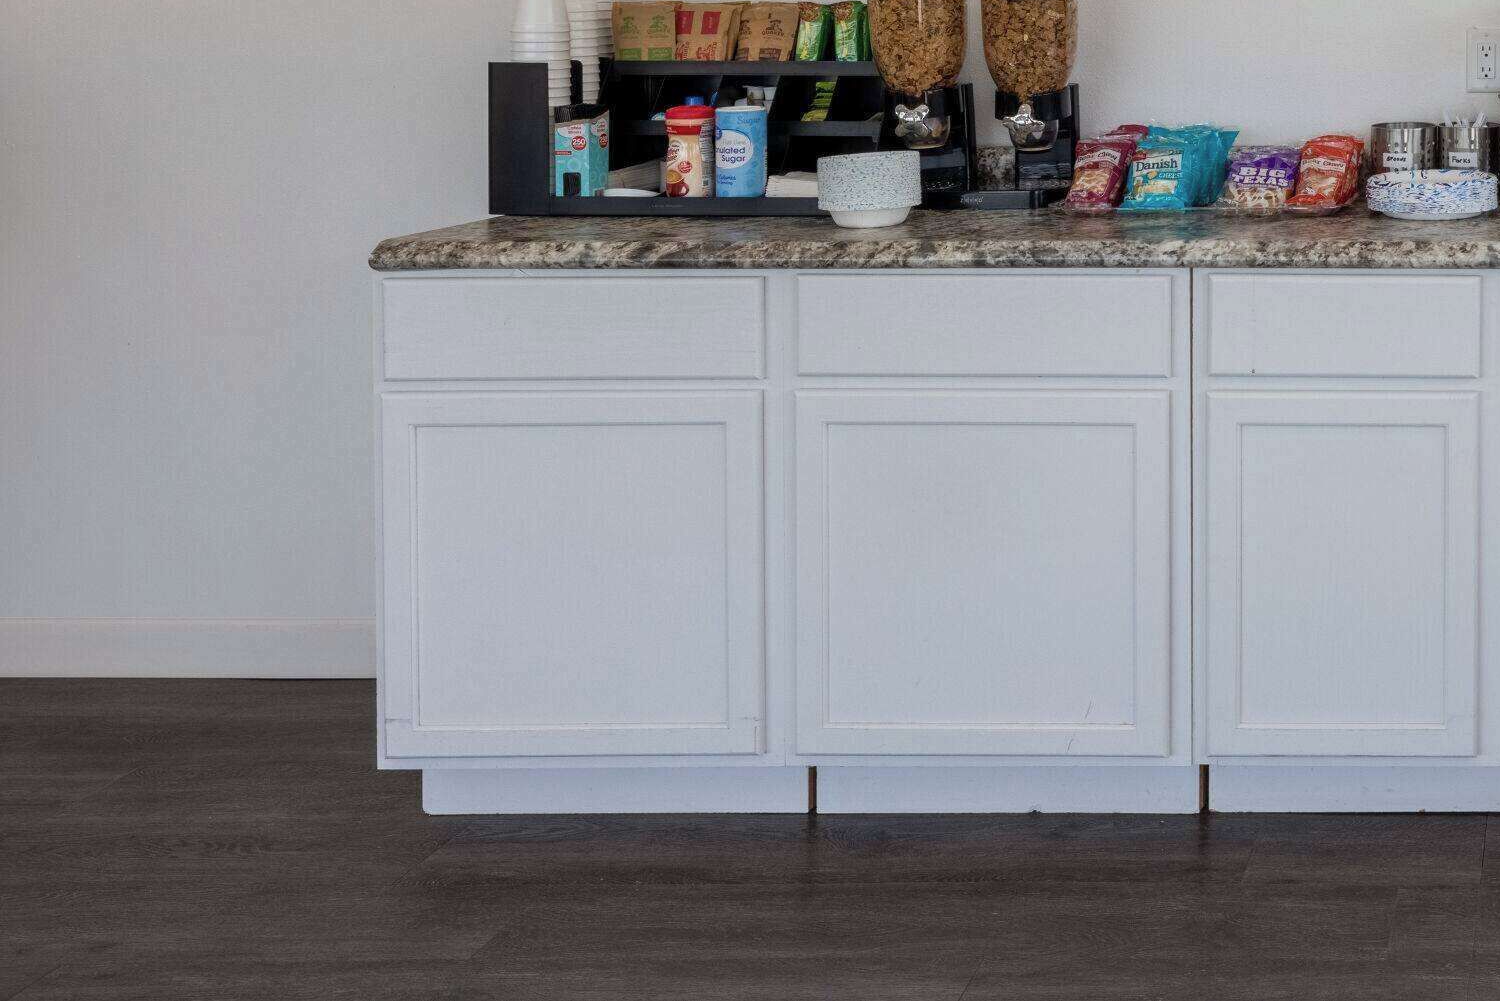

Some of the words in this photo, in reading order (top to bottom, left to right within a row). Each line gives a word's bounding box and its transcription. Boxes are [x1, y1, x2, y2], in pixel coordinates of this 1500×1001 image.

[721, 154, 746, 164] Sugar
[1135, 158, 1179, 172] Danish
[1238, 166, 1287, 179] BIG
[1231, 173, 1289, 188] TEXAS
